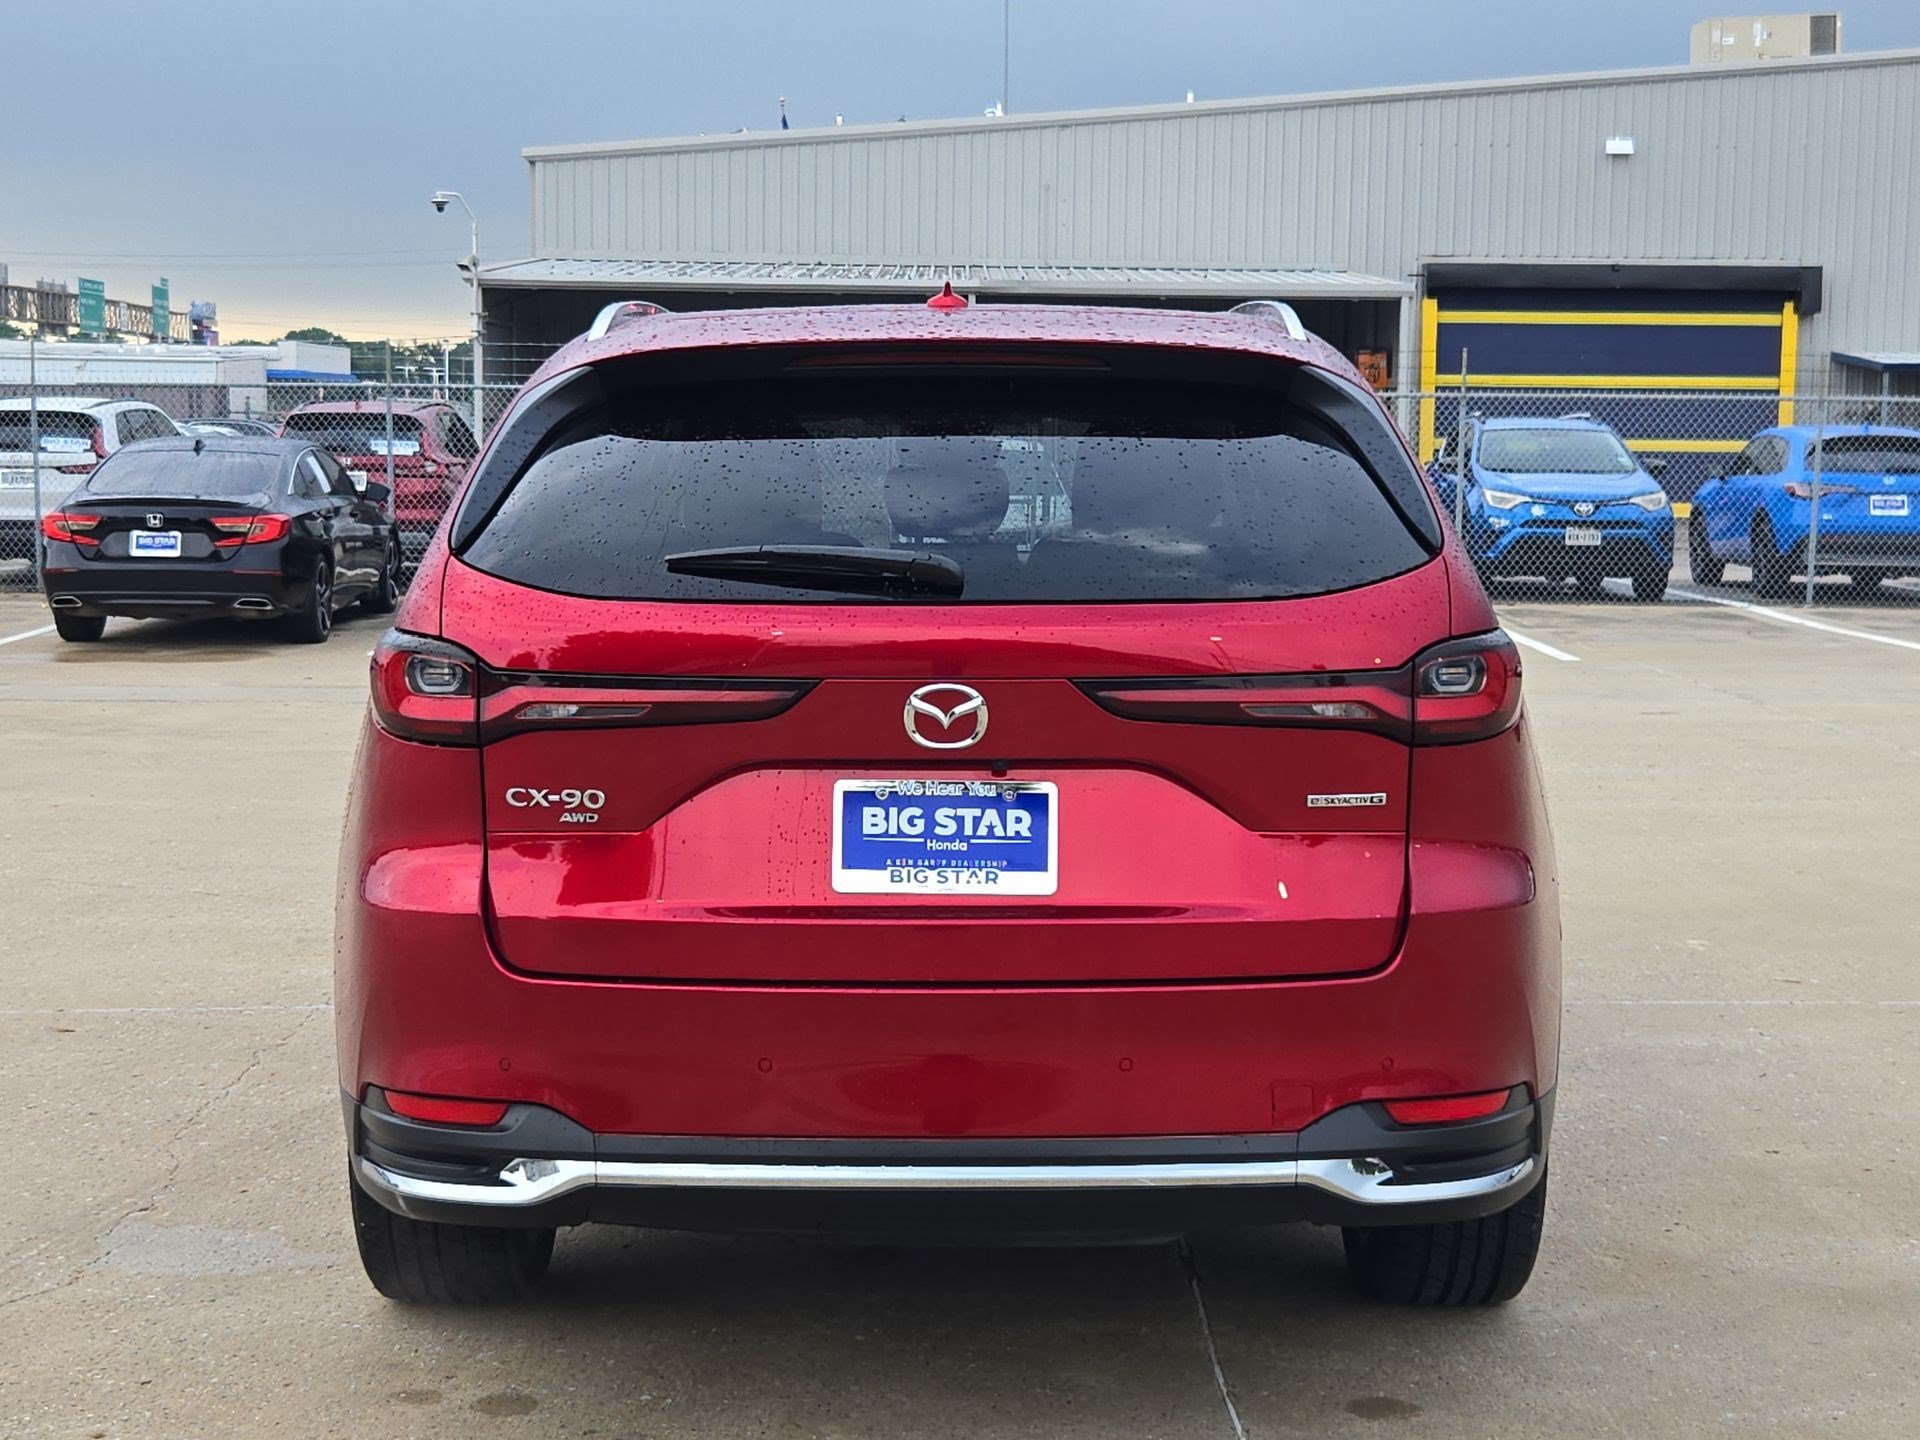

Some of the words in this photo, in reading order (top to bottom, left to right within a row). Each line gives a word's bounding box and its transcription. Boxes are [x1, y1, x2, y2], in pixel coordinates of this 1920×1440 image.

[897, 780, 923, 795] We
[926, 780, 964, 796] Hear
[965, 781, 997, 797] You
[505, 787, 606, 810] CX-90
[559, 812, 599, 823] AWD
[862, 806, 925, 836] BIG
[933, 807, 1032, 837] STAR
[926, 838, 968, 851] Honda
[889, 869, 929, 884] BIG
[936, 869, 999, 885] STAR
